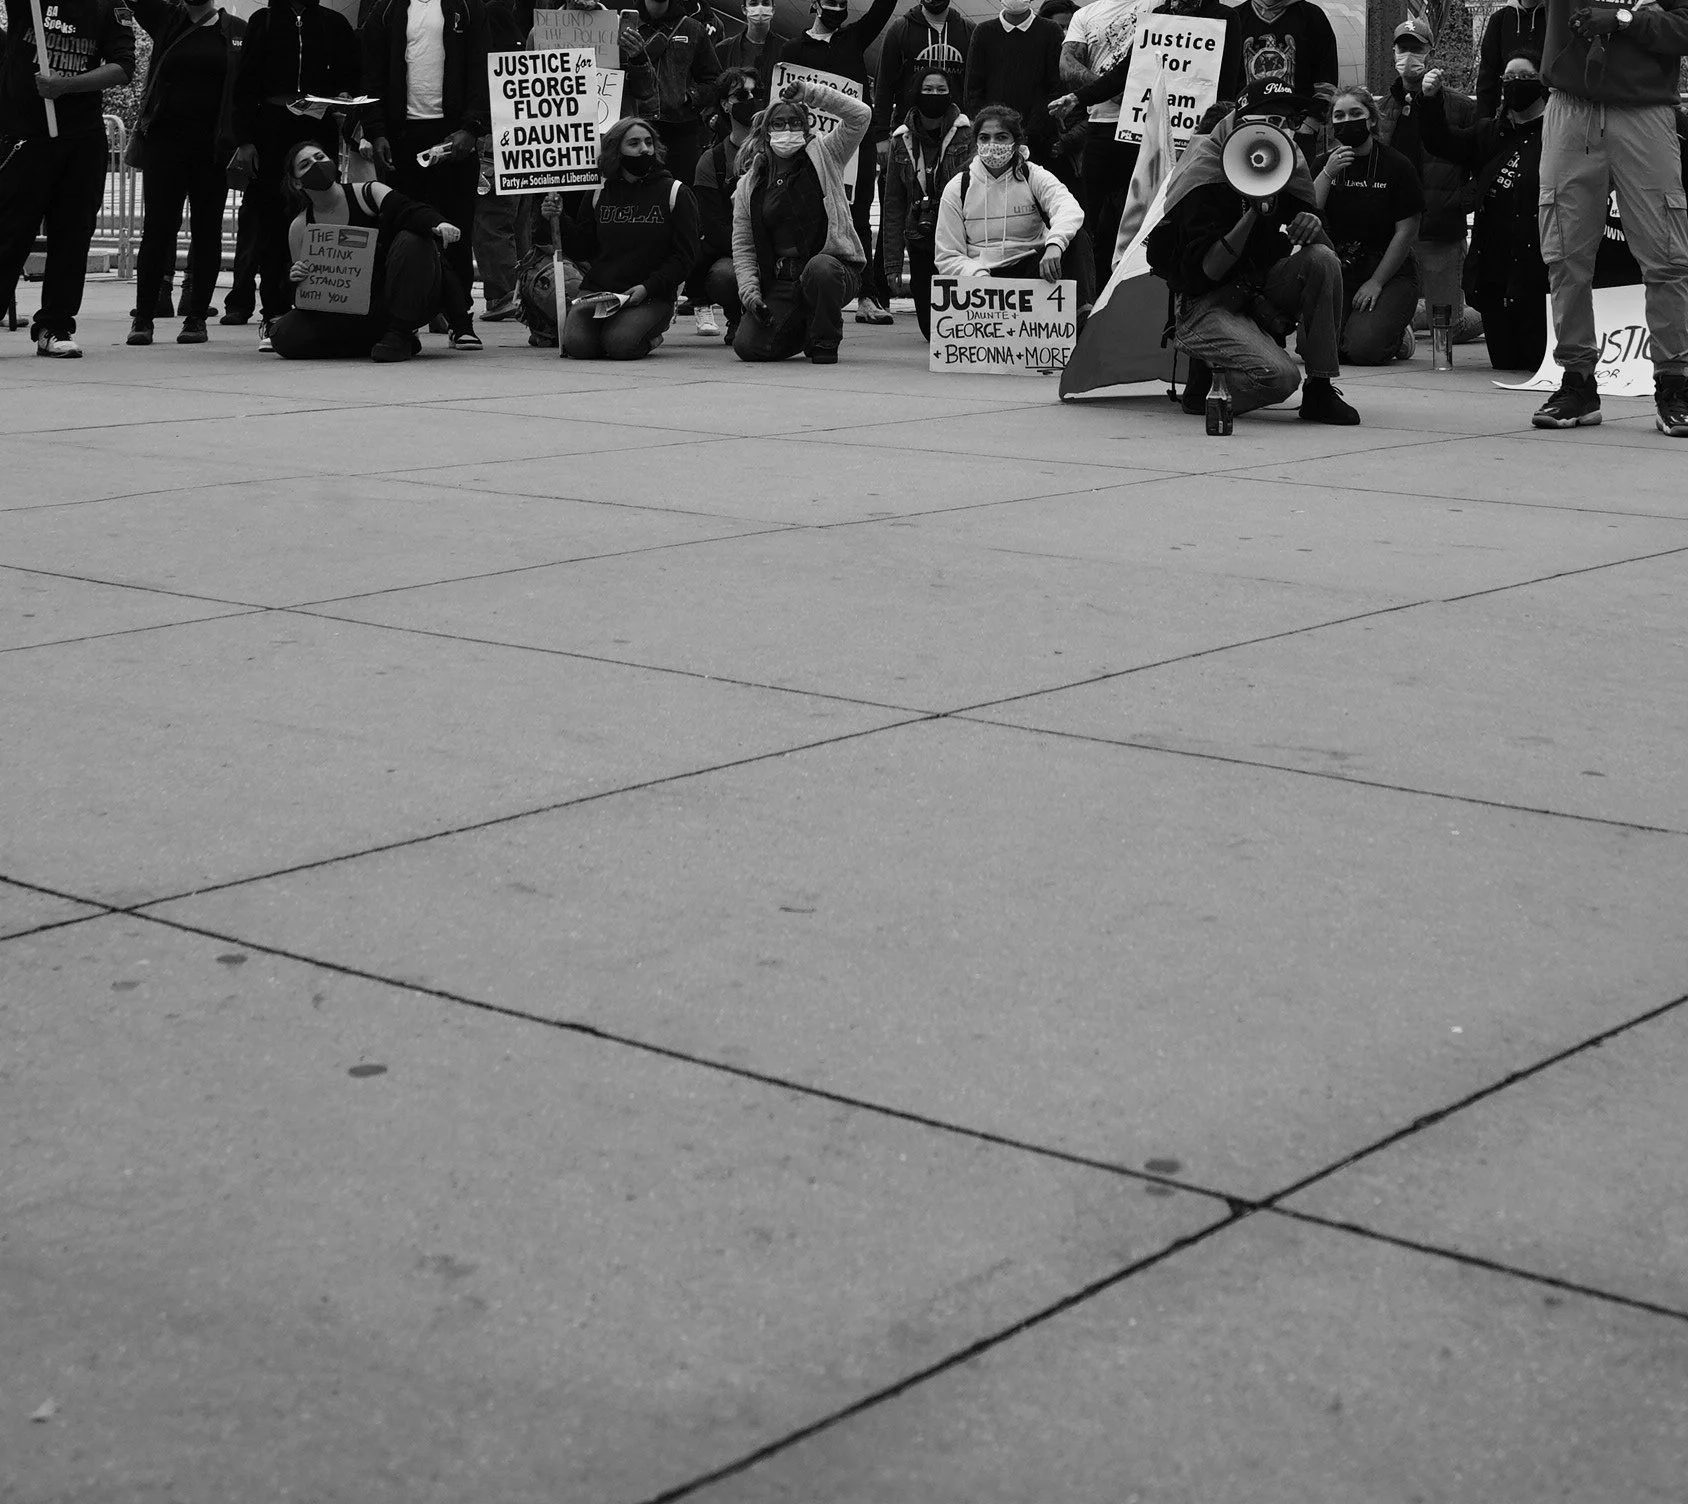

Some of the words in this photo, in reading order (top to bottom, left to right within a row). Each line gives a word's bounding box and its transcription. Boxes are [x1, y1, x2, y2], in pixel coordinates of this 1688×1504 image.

[46, 5, 60, 18] BA
[1139, 29, 1216, 52] Justice
[493, 52, 571, 77] JUSTICE
[575, 54, 592, 74] for
[1161, 53, 1192, 73] for
[502, 75, 587, 100] GEORGE
[1263, 82, 1293, 95] Pilsen
[513, 96, 579, 120] FLOYD
[1140, 88, 1196, 109] Aam
[500, 130, 510, 147] &
[513, 122, 595, 147] DAUNTE
[501, 145, 596, 171] WRIGHT!!
[502, 176, 520, 189] Party
[520, 177, 529, 187] for
[529, 174, 561, 186] Socialism
[566, 171, 599, 183] Liberation
[600, 205, 665, 224] UCLA
[308, 228, 334, 243] THE
[309, 244, 354, 260] LATINX
[309, 274, 352, 288] STANDS
[300, 289, 321, 300] WITH
[328, 292, 348, 304] YOU
[930, 279, 1034, 313] JUSTICE
[1046, 284, 1066, 313] 4
[965, 310, 1010, 322] DAUNTE
[936, 315, 1005, 340] GEORGE
[1018, 320, 1076, 340] AHMAUD
[944, 344, 1015, 365] BREONNA
[1024, 346, 1071, 367] MORE
